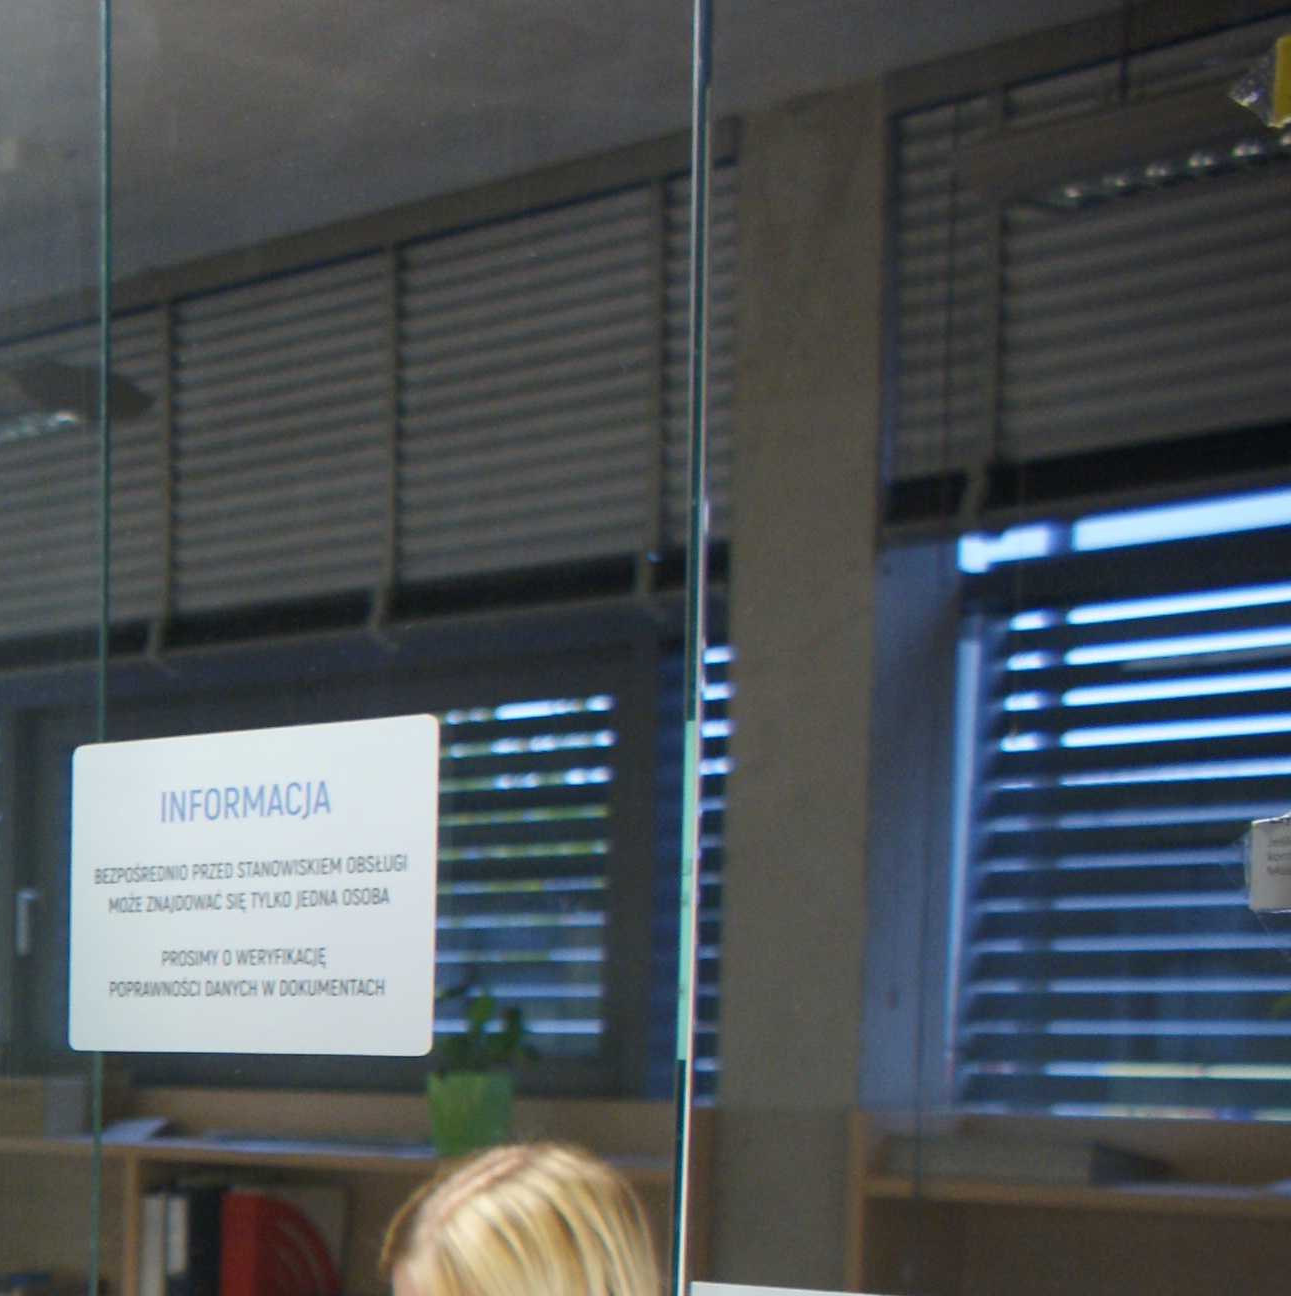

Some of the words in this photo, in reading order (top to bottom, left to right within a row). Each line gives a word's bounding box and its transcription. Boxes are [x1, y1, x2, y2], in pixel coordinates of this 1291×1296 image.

[160, 780, 331, 823] INFORMACJA
[94, 863, 189, 884] BEZPOŚREDNIO
[192, 862, 233, 880] PRZED
[237, 857, 342, 878] STANOWISKIEM
[346, 854, 408, 874] OBSŁUGI
[108, 892, 143, 913] MOŻE
[146, 889, 223, 913] ZNAJDOWAĆ
[226, 891, 247, 913] SIĘ
[251, 891, 292, 909] TYLKO
[295, 889, 338, 910] JEDNA
[342, 887, 391, 906] OSOBA
[161, 950, 219, 967] PROSIMY
[222, 949, 233, 966] O
[236, 947, 327, 969] WERYFIKACJĘ
[109, 977, 201, 998] POPRAWNOŚCI
[205, 979, 258, 997] DANYCH
[261, 980, 276, 996] W
[279, 979, 386, 997] DOKUMENTACH
